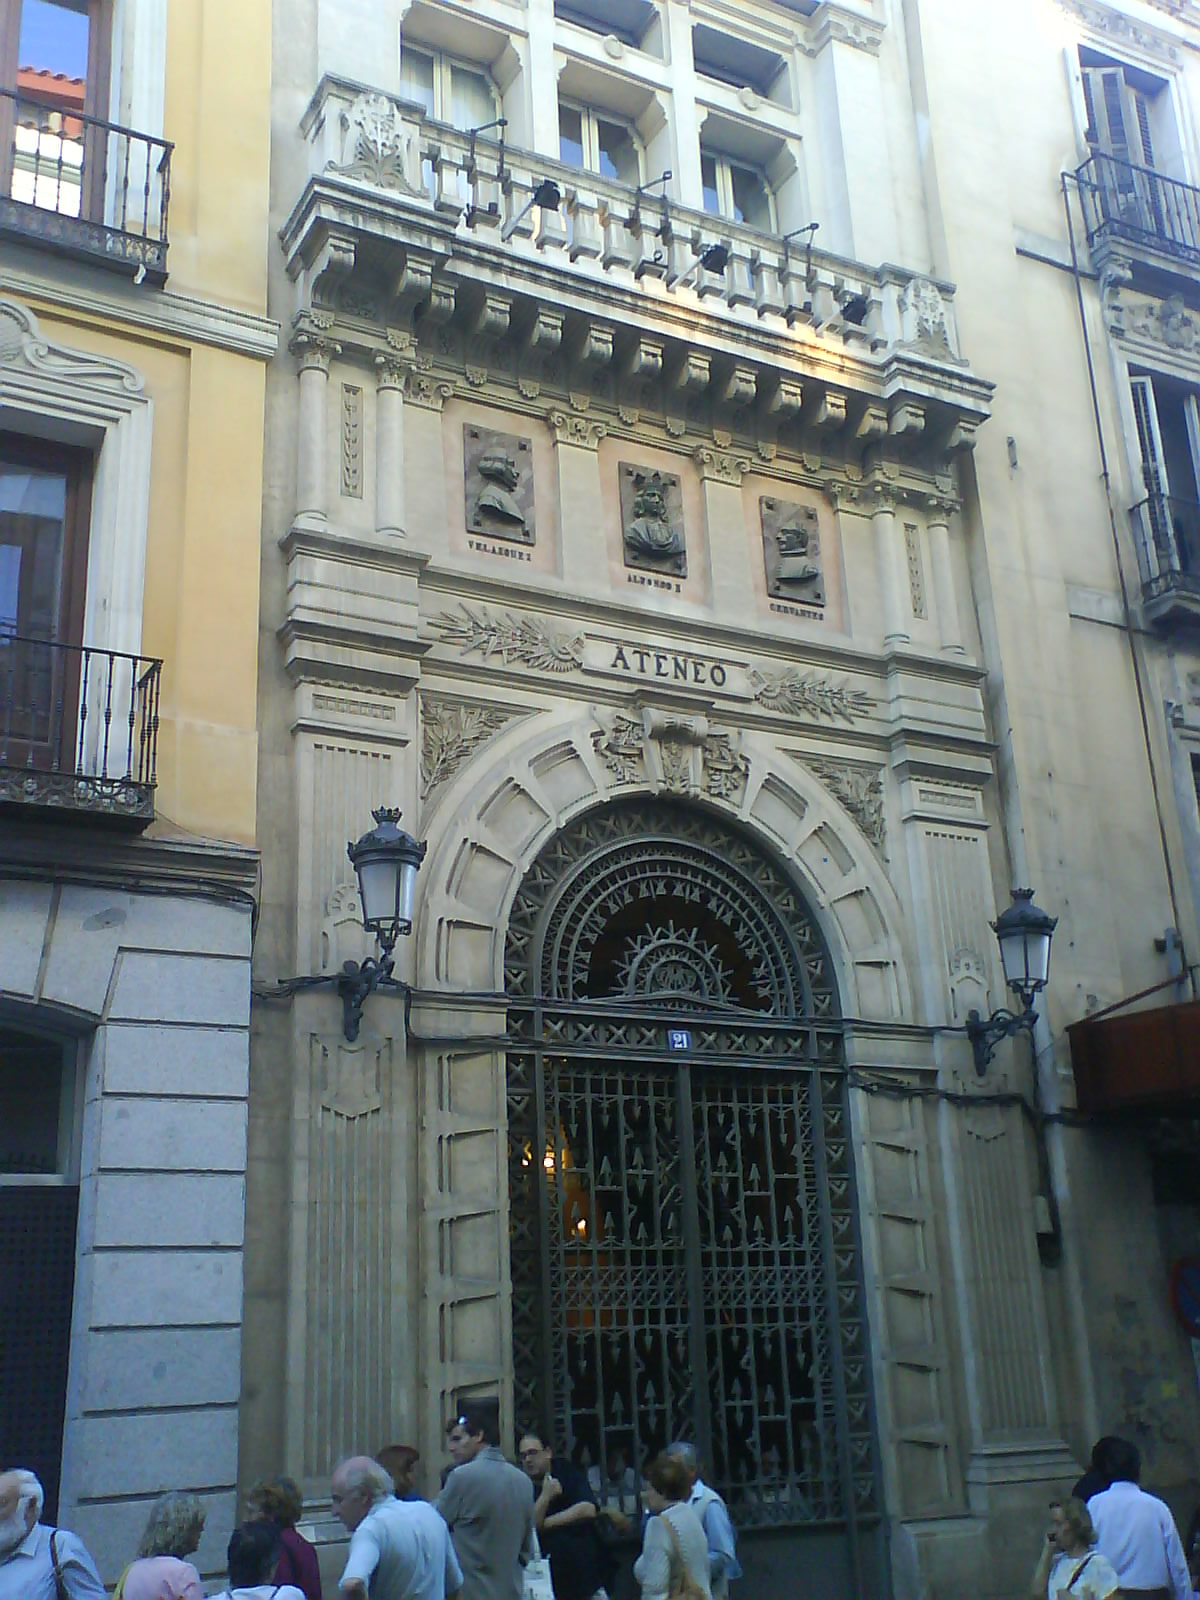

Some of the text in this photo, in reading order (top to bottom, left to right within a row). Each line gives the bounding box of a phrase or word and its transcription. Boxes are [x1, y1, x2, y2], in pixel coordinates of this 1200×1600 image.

[627, 574, 673, 591] ALFONSO
[769, 602, 824, 621] CERVANTES
[610, 645, 727, 687] ATENEO
[672, 1032, 688, 1049] 21
